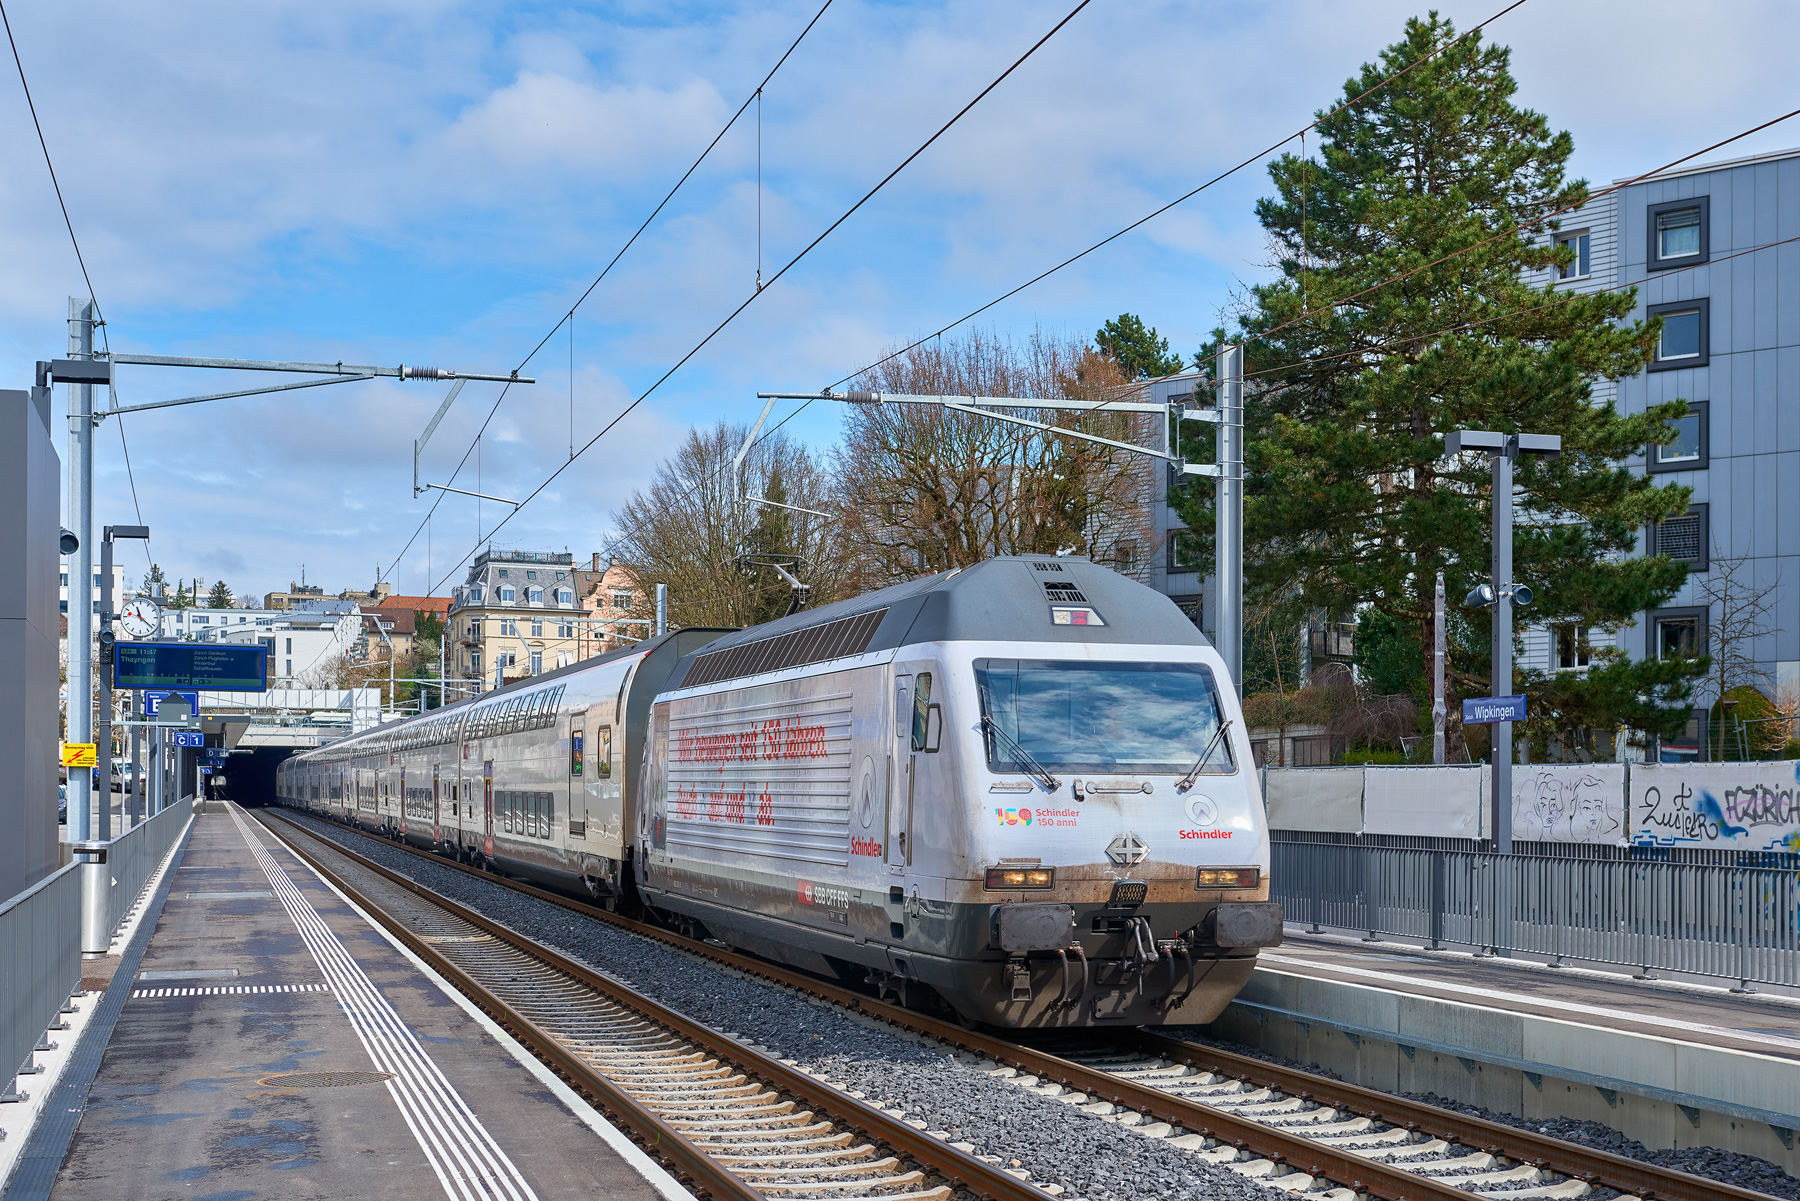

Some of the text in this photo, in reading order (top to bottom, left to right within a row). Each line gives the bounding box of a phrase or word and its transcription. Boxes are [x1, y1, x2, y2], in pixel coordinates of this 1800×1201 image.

[120, 656, 156, 664] Thayngen
[1474, 705, 1515, 721] Wipkingen
[194, 737, 199, 745] 1
[739, 721, 758, 761] seit
[761, 719, 782, 760] 150
[1036, 808, 1080, 817] Schindler
[1037, 818, 1077, 826] 150 anni
[1179, 829, 1233, 839] Schindler
[851, 836, 880, 857] Schindler
[814, 886, 849, 909] SBB CFF FFS
